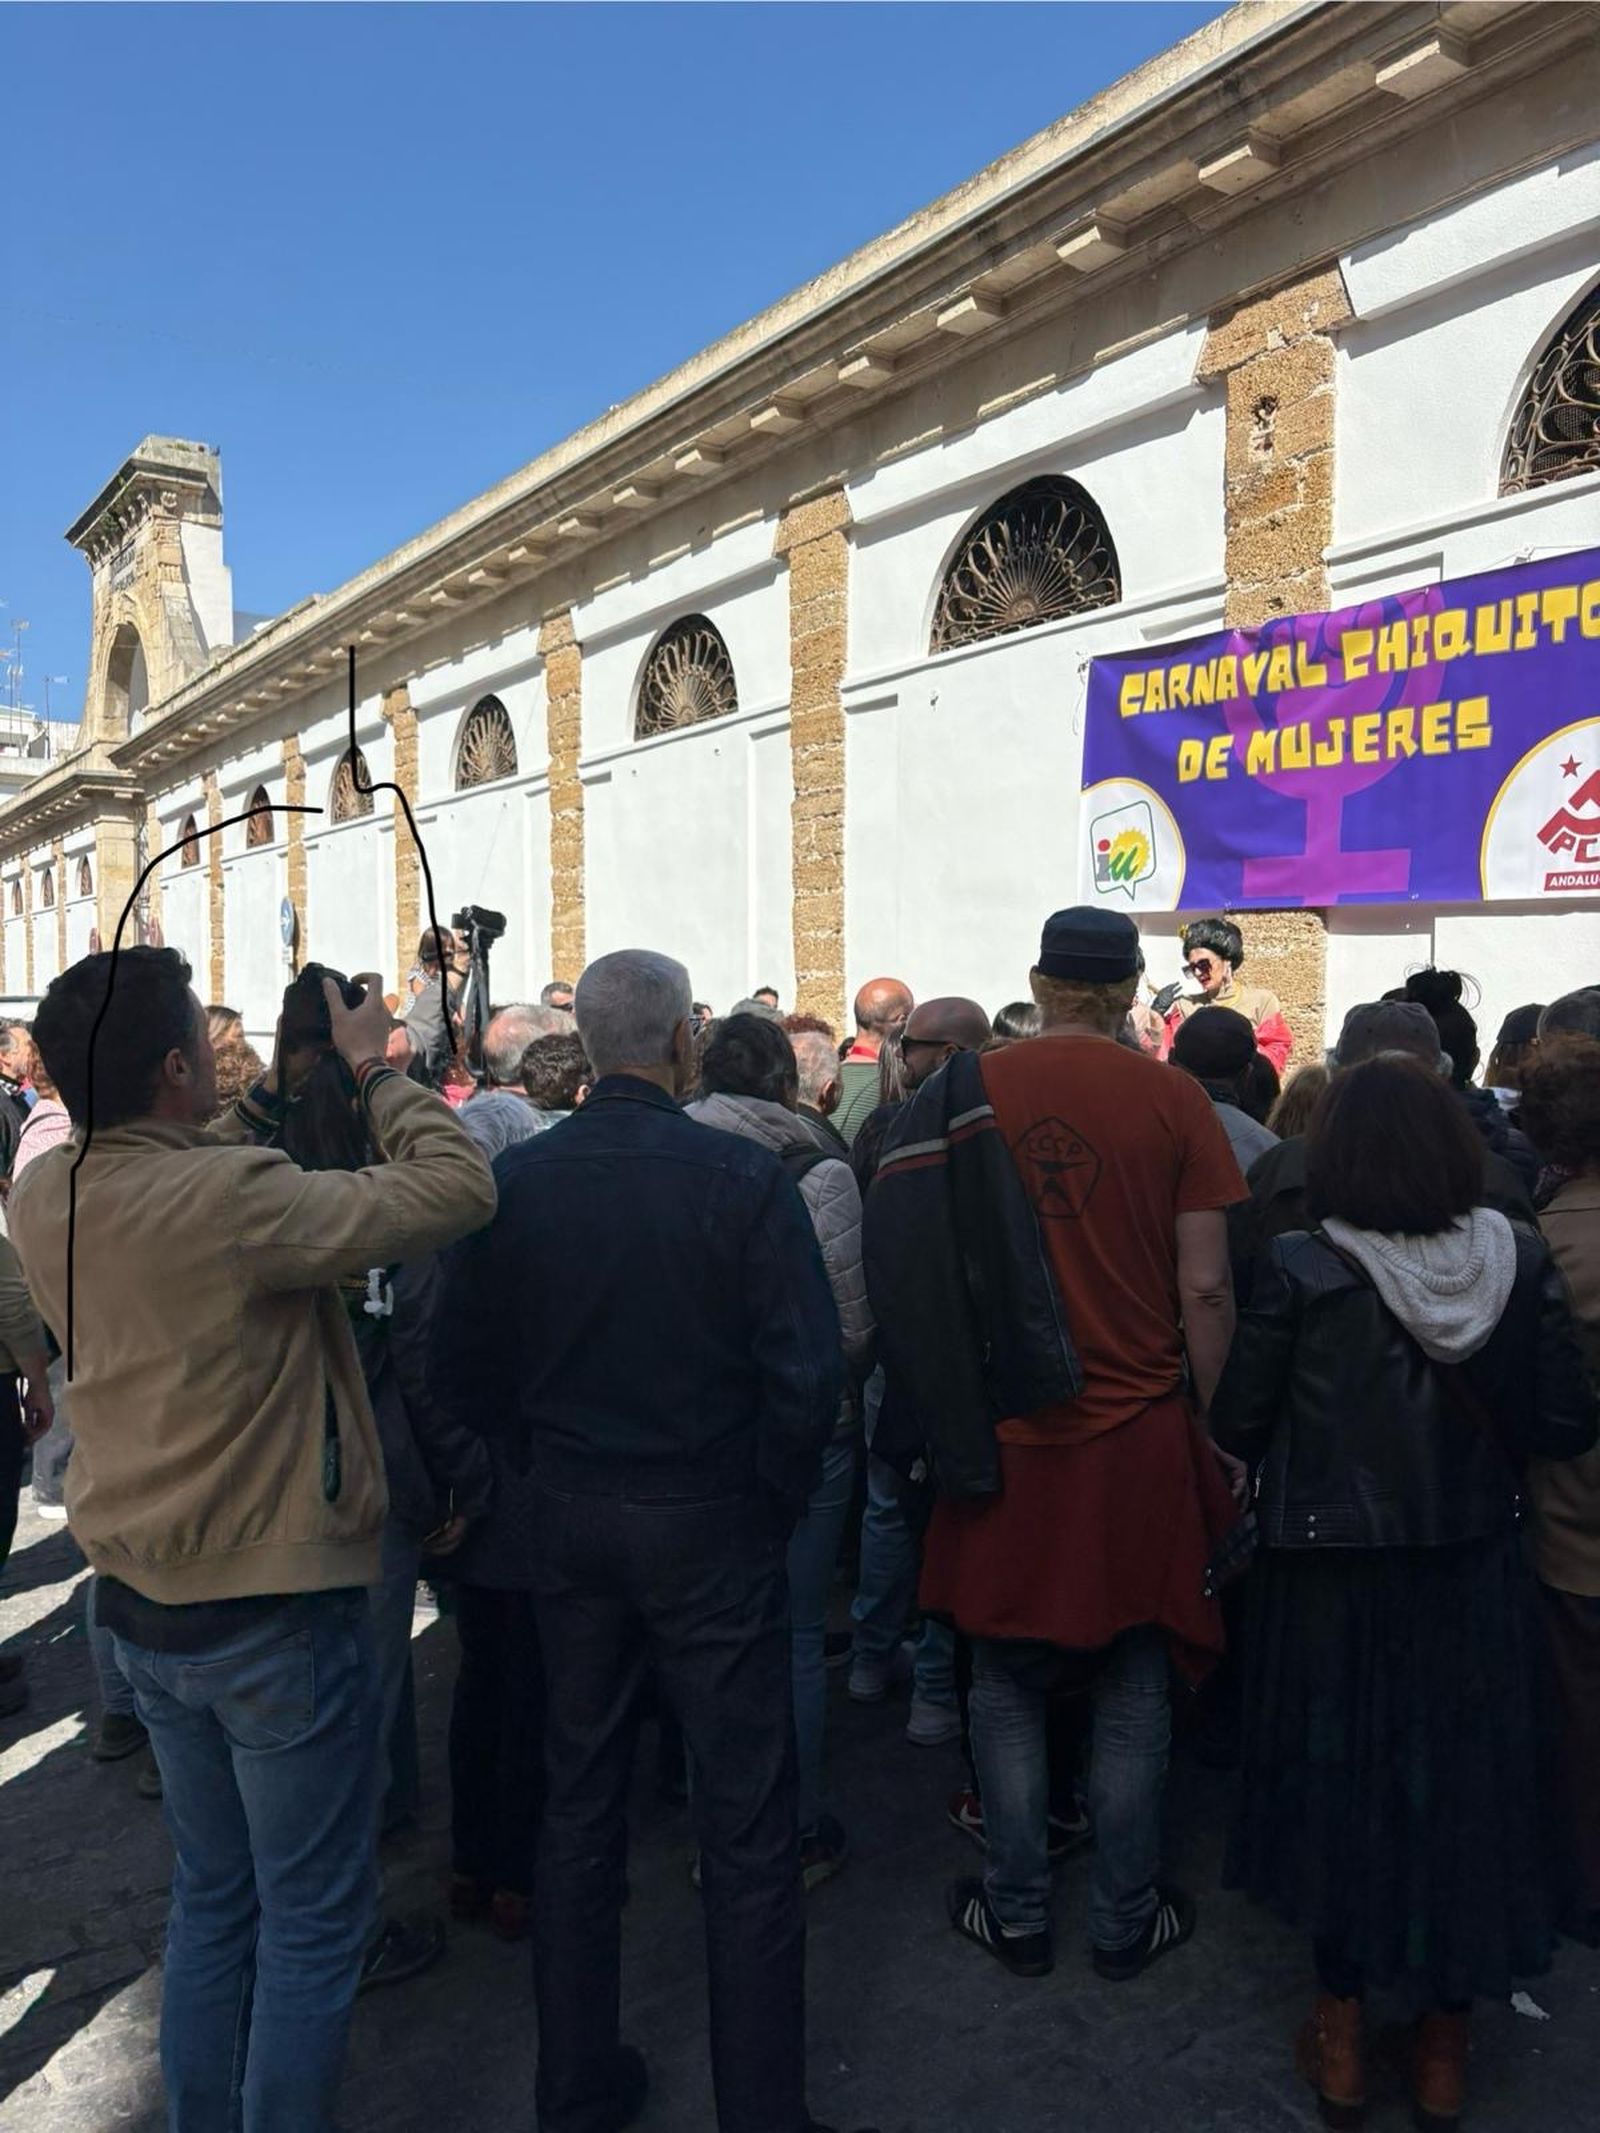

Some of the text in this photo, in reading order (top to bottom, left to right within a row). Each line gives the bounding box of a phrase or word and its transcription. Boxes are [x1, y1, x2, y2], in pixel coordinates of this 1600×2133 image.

[1120, 641, 1327, 718] CARNAVAL
[1178, 696, 1493, 783] DE MUJERES
[1549, 874, 1600, 887] ANDALU
